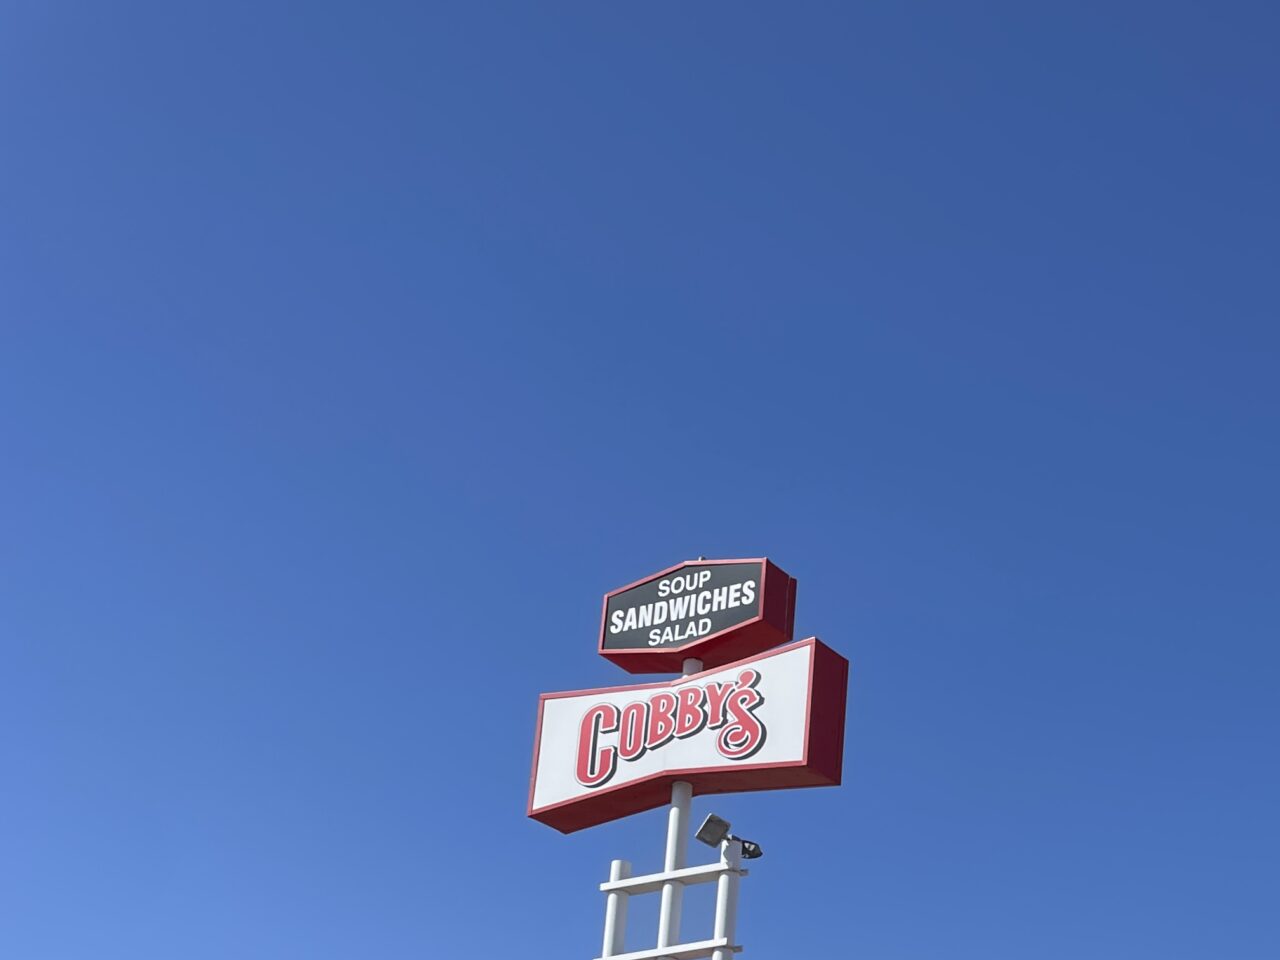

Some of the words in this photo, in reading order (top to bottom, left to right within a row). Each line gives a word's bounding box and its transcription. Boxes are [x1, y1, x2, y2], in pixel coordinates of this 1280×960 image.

[658, 570, 711, 597] SOUP
[609, 580, 756, 634] SANDWICHES
[648, 618, 712, 646] SALAD
[575, 668, 767, 788] COBBY'S
